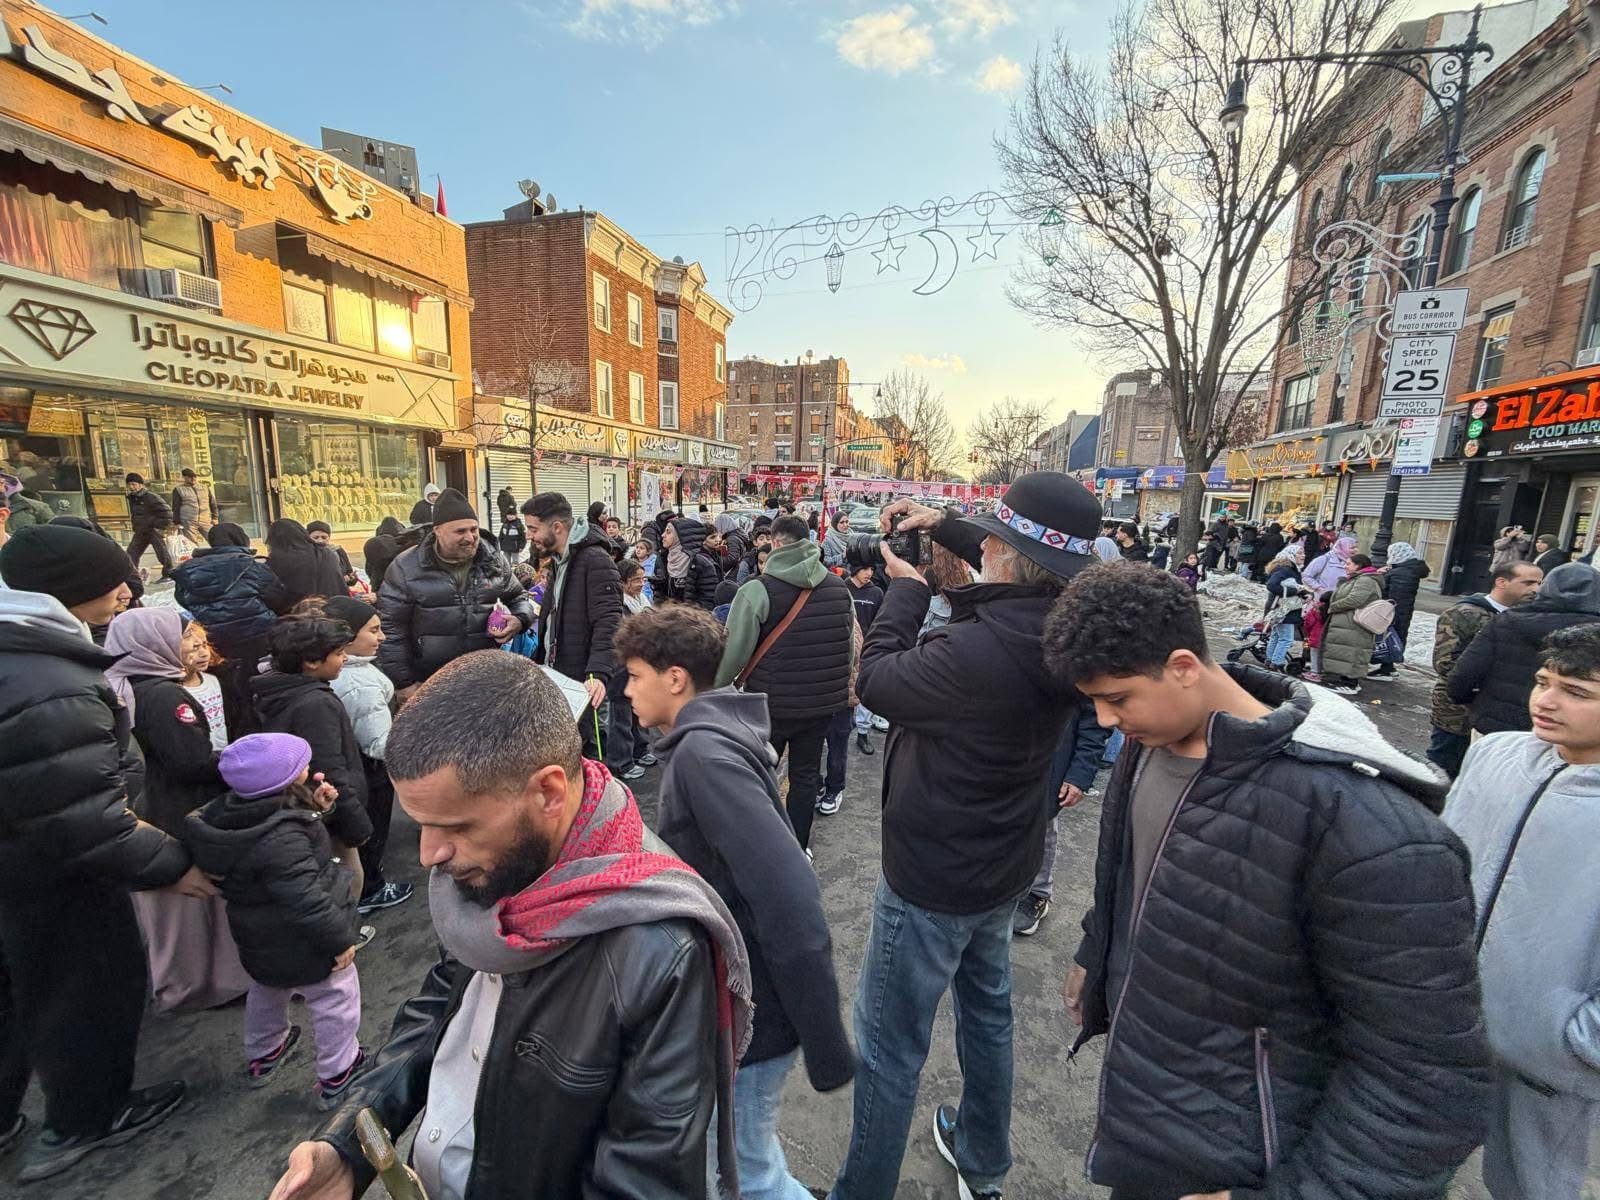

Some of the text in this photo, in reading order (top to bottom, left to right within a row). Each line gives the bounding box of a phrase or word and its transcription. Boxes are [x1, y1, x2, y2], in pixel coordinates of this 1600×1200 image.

[1420, 311, 1455, 320] CORRIDOR
[1421, 321, 1458, 329] ENFORCED
[129, 314, 258, 365] كليوباترا
[1401, 349, 1438, 357] SPEED
[145, 361, 364, 410] CLEOPATRA JEWELRY
[1392, 369, 1439, 391] 25
[1532, 381, 1600, 426] Zah
[1529, 420, 1600, 439] FOOD MAR
